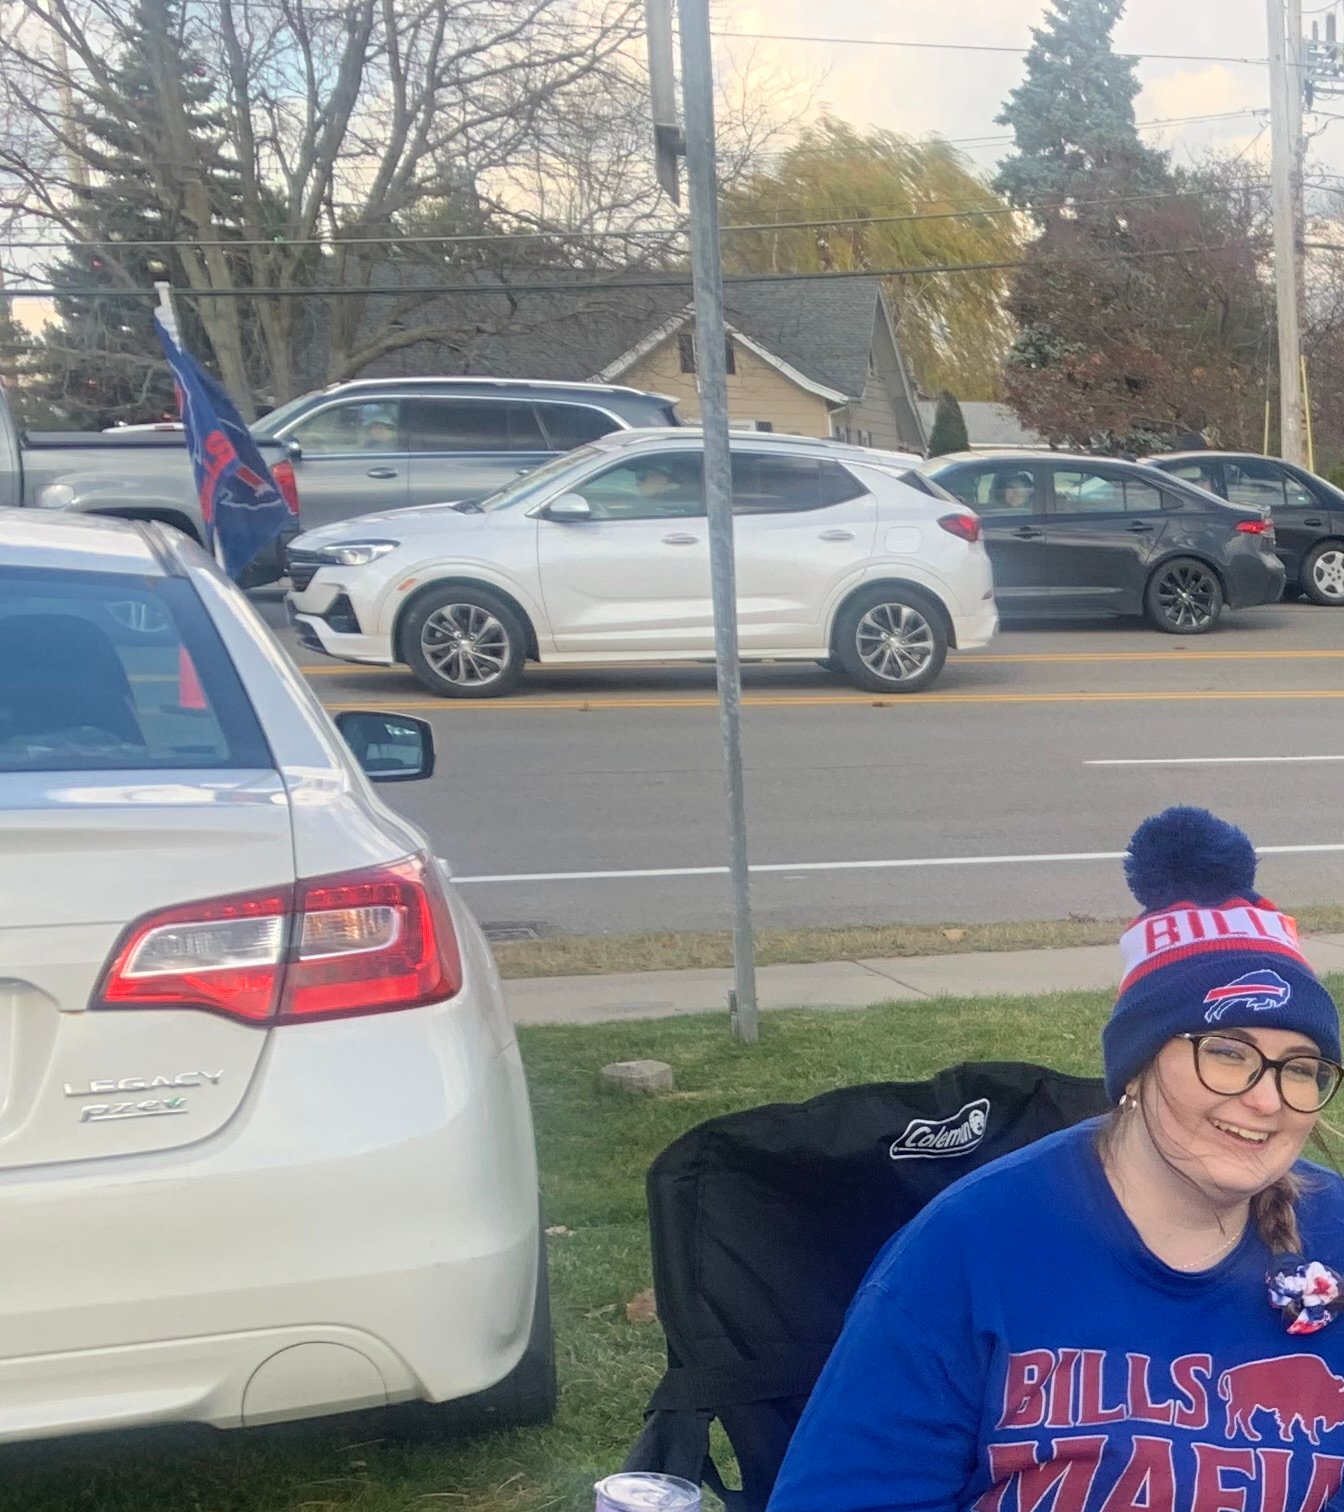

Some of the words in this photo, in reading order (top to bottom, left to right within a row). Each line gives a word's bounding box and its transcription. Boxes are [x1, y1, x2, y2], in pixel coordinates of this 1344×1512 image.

[64, 1069, 225, 1097] LEGACY
[904, 1121, 972, 1149] Coleman
[995, 1348, 1213, 1430] BILLS
